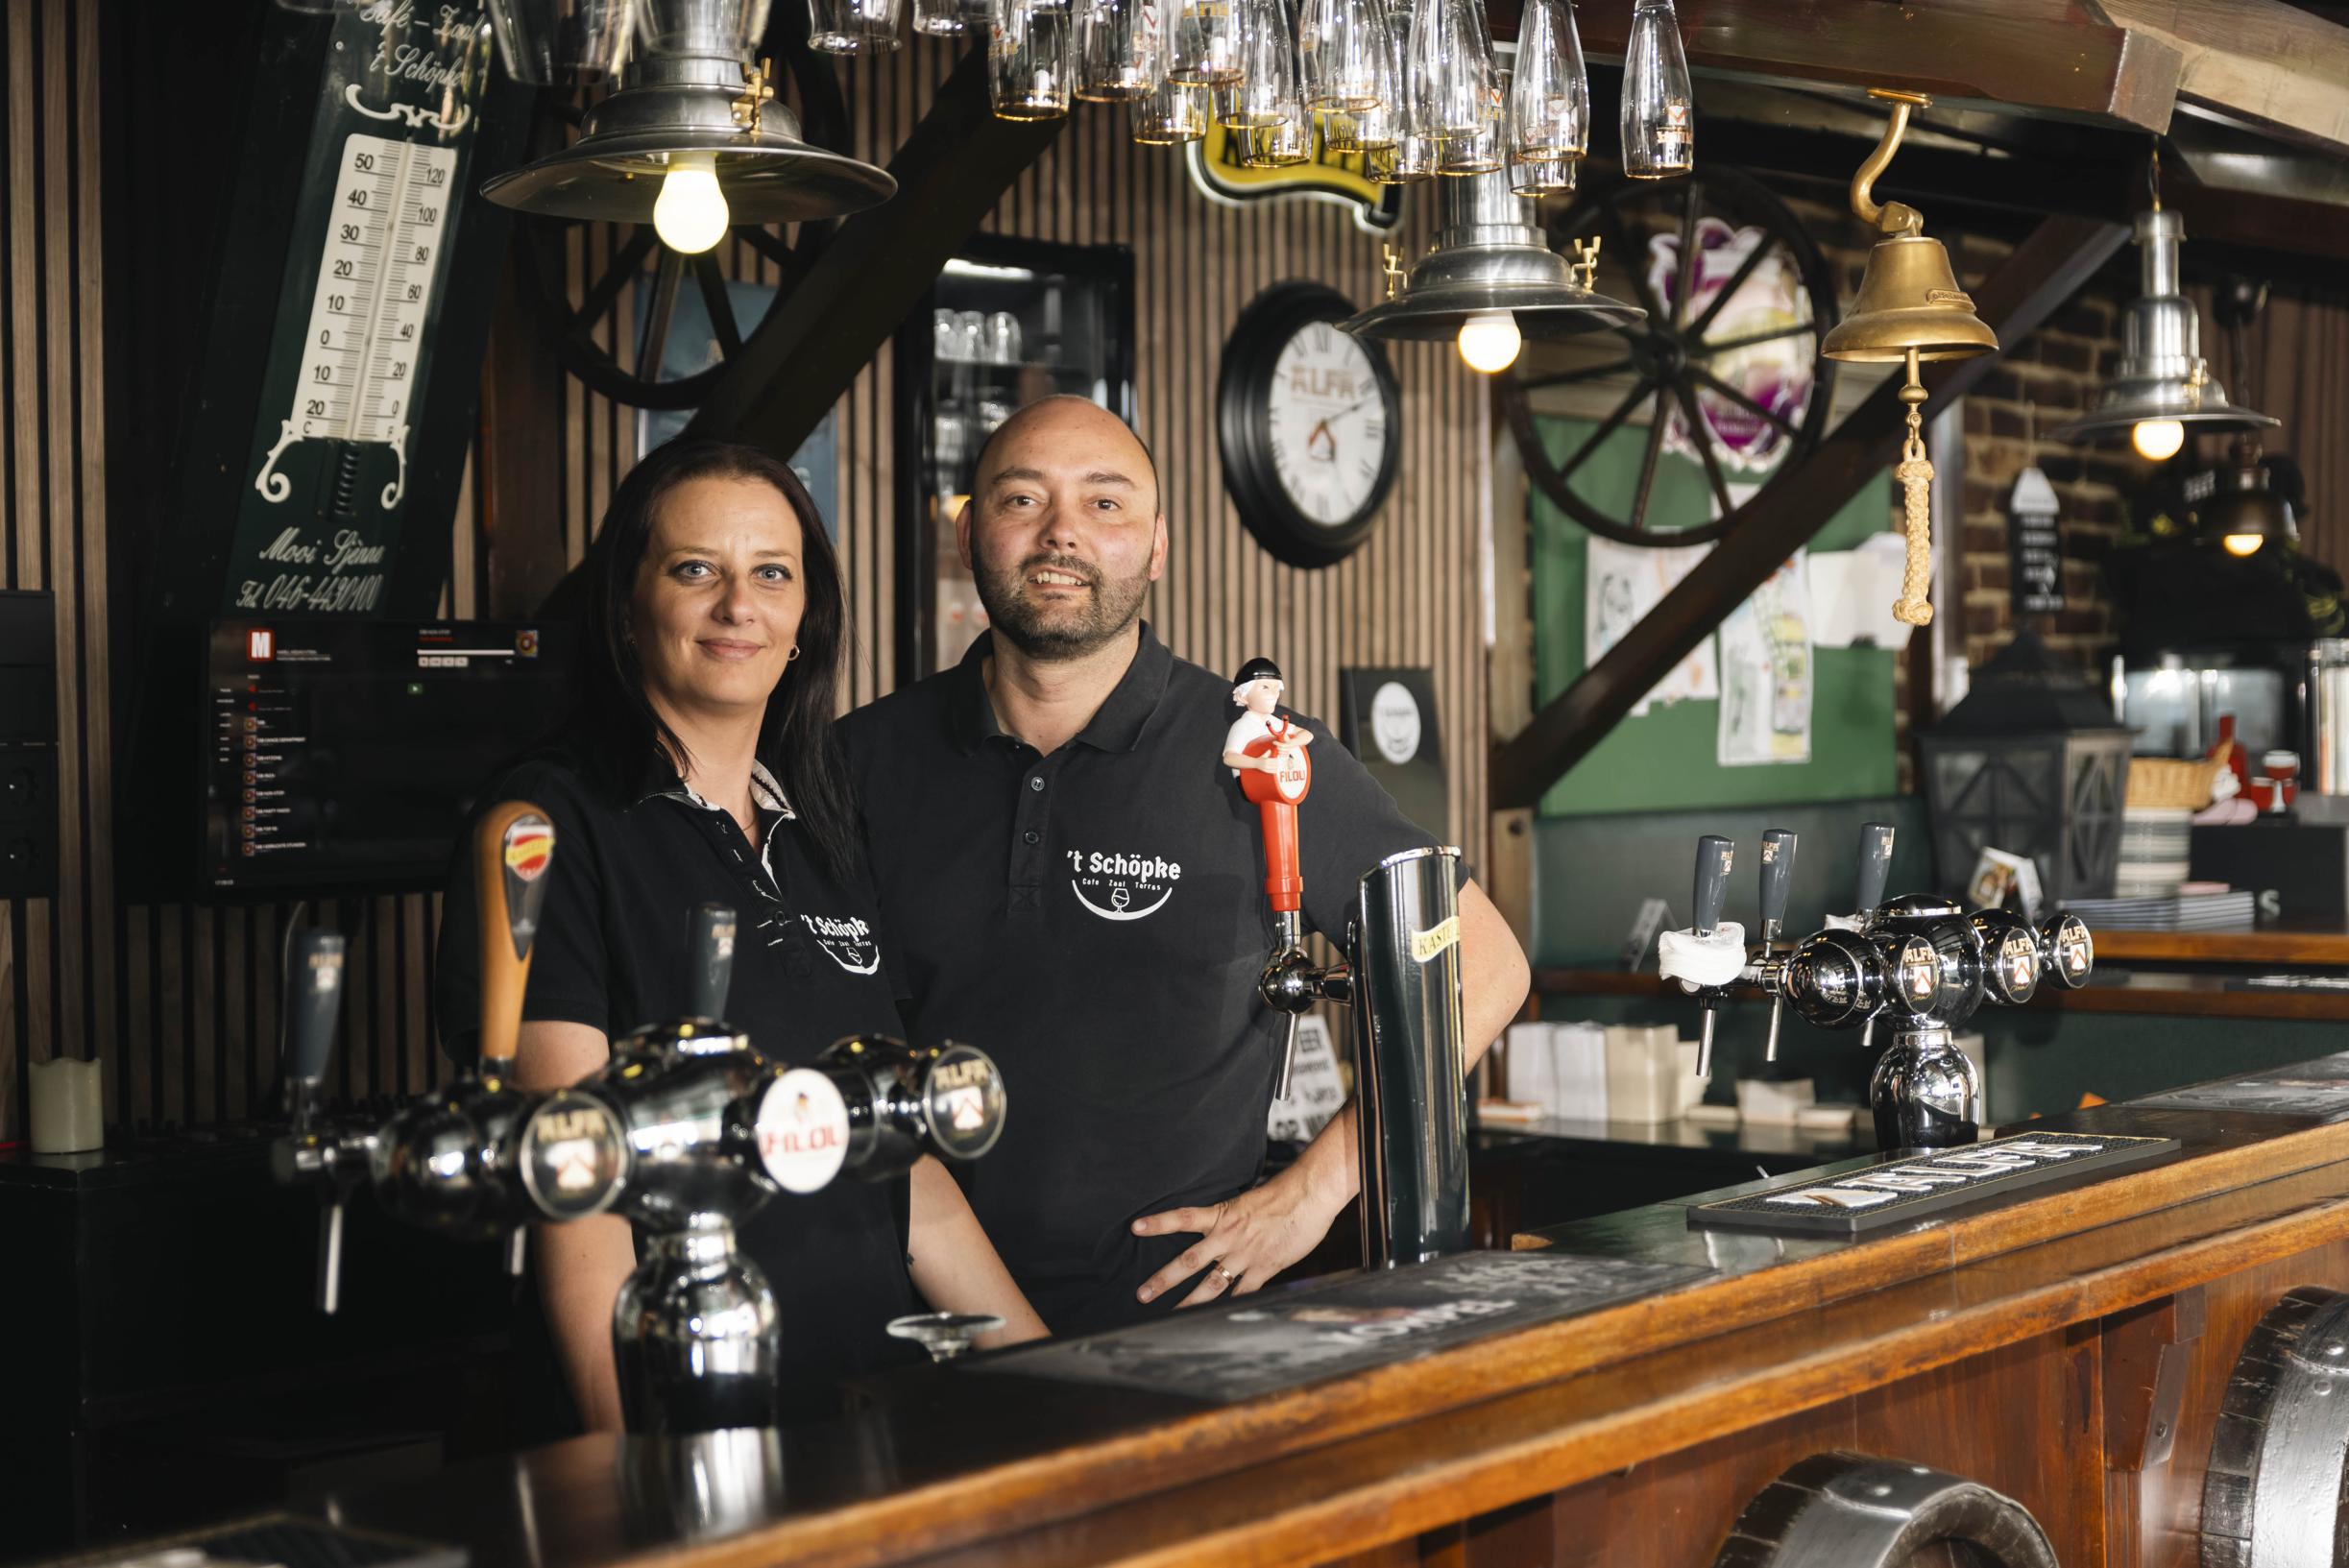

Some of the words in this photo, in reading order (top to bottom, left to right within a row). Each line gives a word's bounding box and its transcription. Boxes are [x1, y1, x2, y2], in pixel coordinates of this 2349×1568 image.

[384, 44, 464, 93] Schöpke
[354, 153, 375, 170] 50
[426, 168, 446, 184] 120
[347, 189, 368, 205] 40
[417, 206, 437, 223] 100
[340, 224, 359, 240] 30
[415, 246, 429, 262] 80
[333, 259, 352, 277] 20
[407, 284, 423, 301] 60
[327, 294, 345, 311] 10
[320, 329, 330, 346] 0
[400, 324, 415, 339] 40
[313, 365, 331, 381] 10
[392, 361, 407, 377] 20
[1291, 364, 1357, 399] ALFA
[305, 399, 326, 416] 20
[391, 399, 400, 416] 0
[303, 421, 312, 435] C
[386, 425, 395, 439] F
[258, 526, 324, 564] Mooi
[251, 631, 272, 659] M
[1067, 850, 1083, 873] 't
[1089, 851, 1181, 883] Schöpke
[2259, 889, 2281, 917] S
[814, 916, 870, 942] Schöpk
[1833, 1141, 2104, 1193] ALFA
